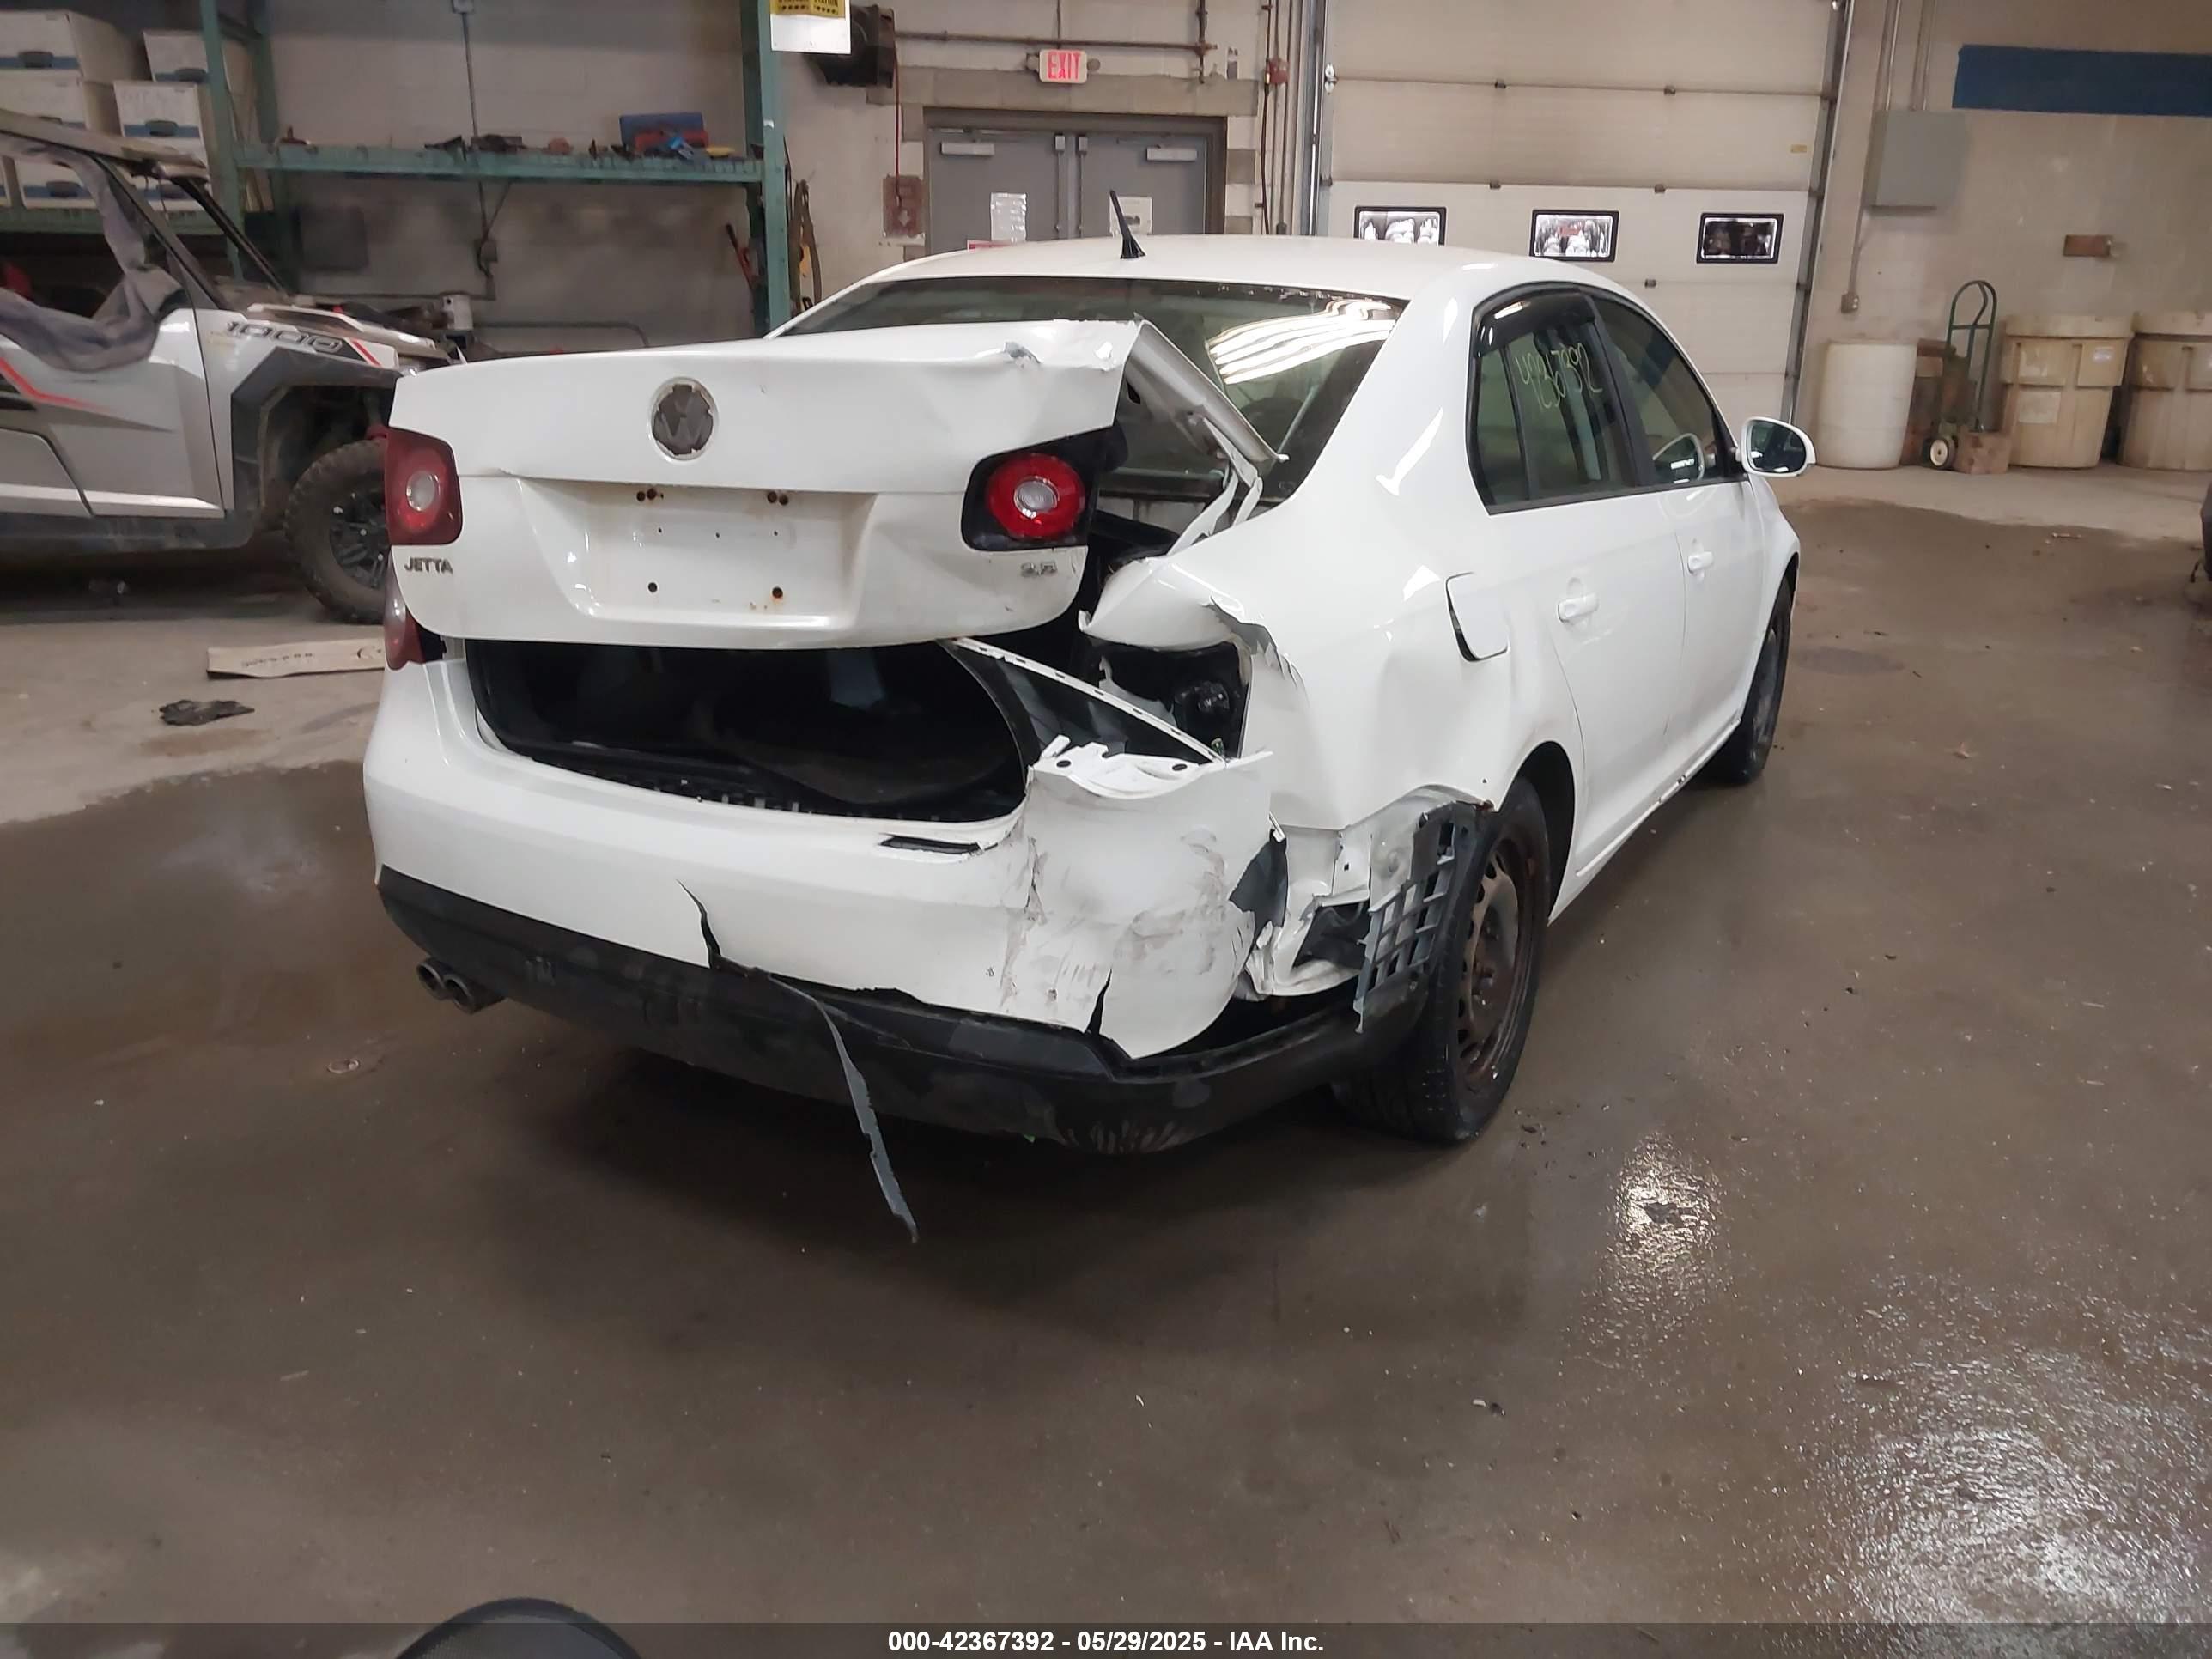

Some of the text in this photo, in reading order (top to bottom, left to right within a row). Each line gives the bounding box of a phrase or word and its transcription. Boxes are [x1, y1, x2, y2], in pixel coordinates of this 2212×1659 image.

[1048, 52, 1081, 79] EXIT
[227, 321, 343, 353] 1000
[404, 556, 454, 574] JETTA
